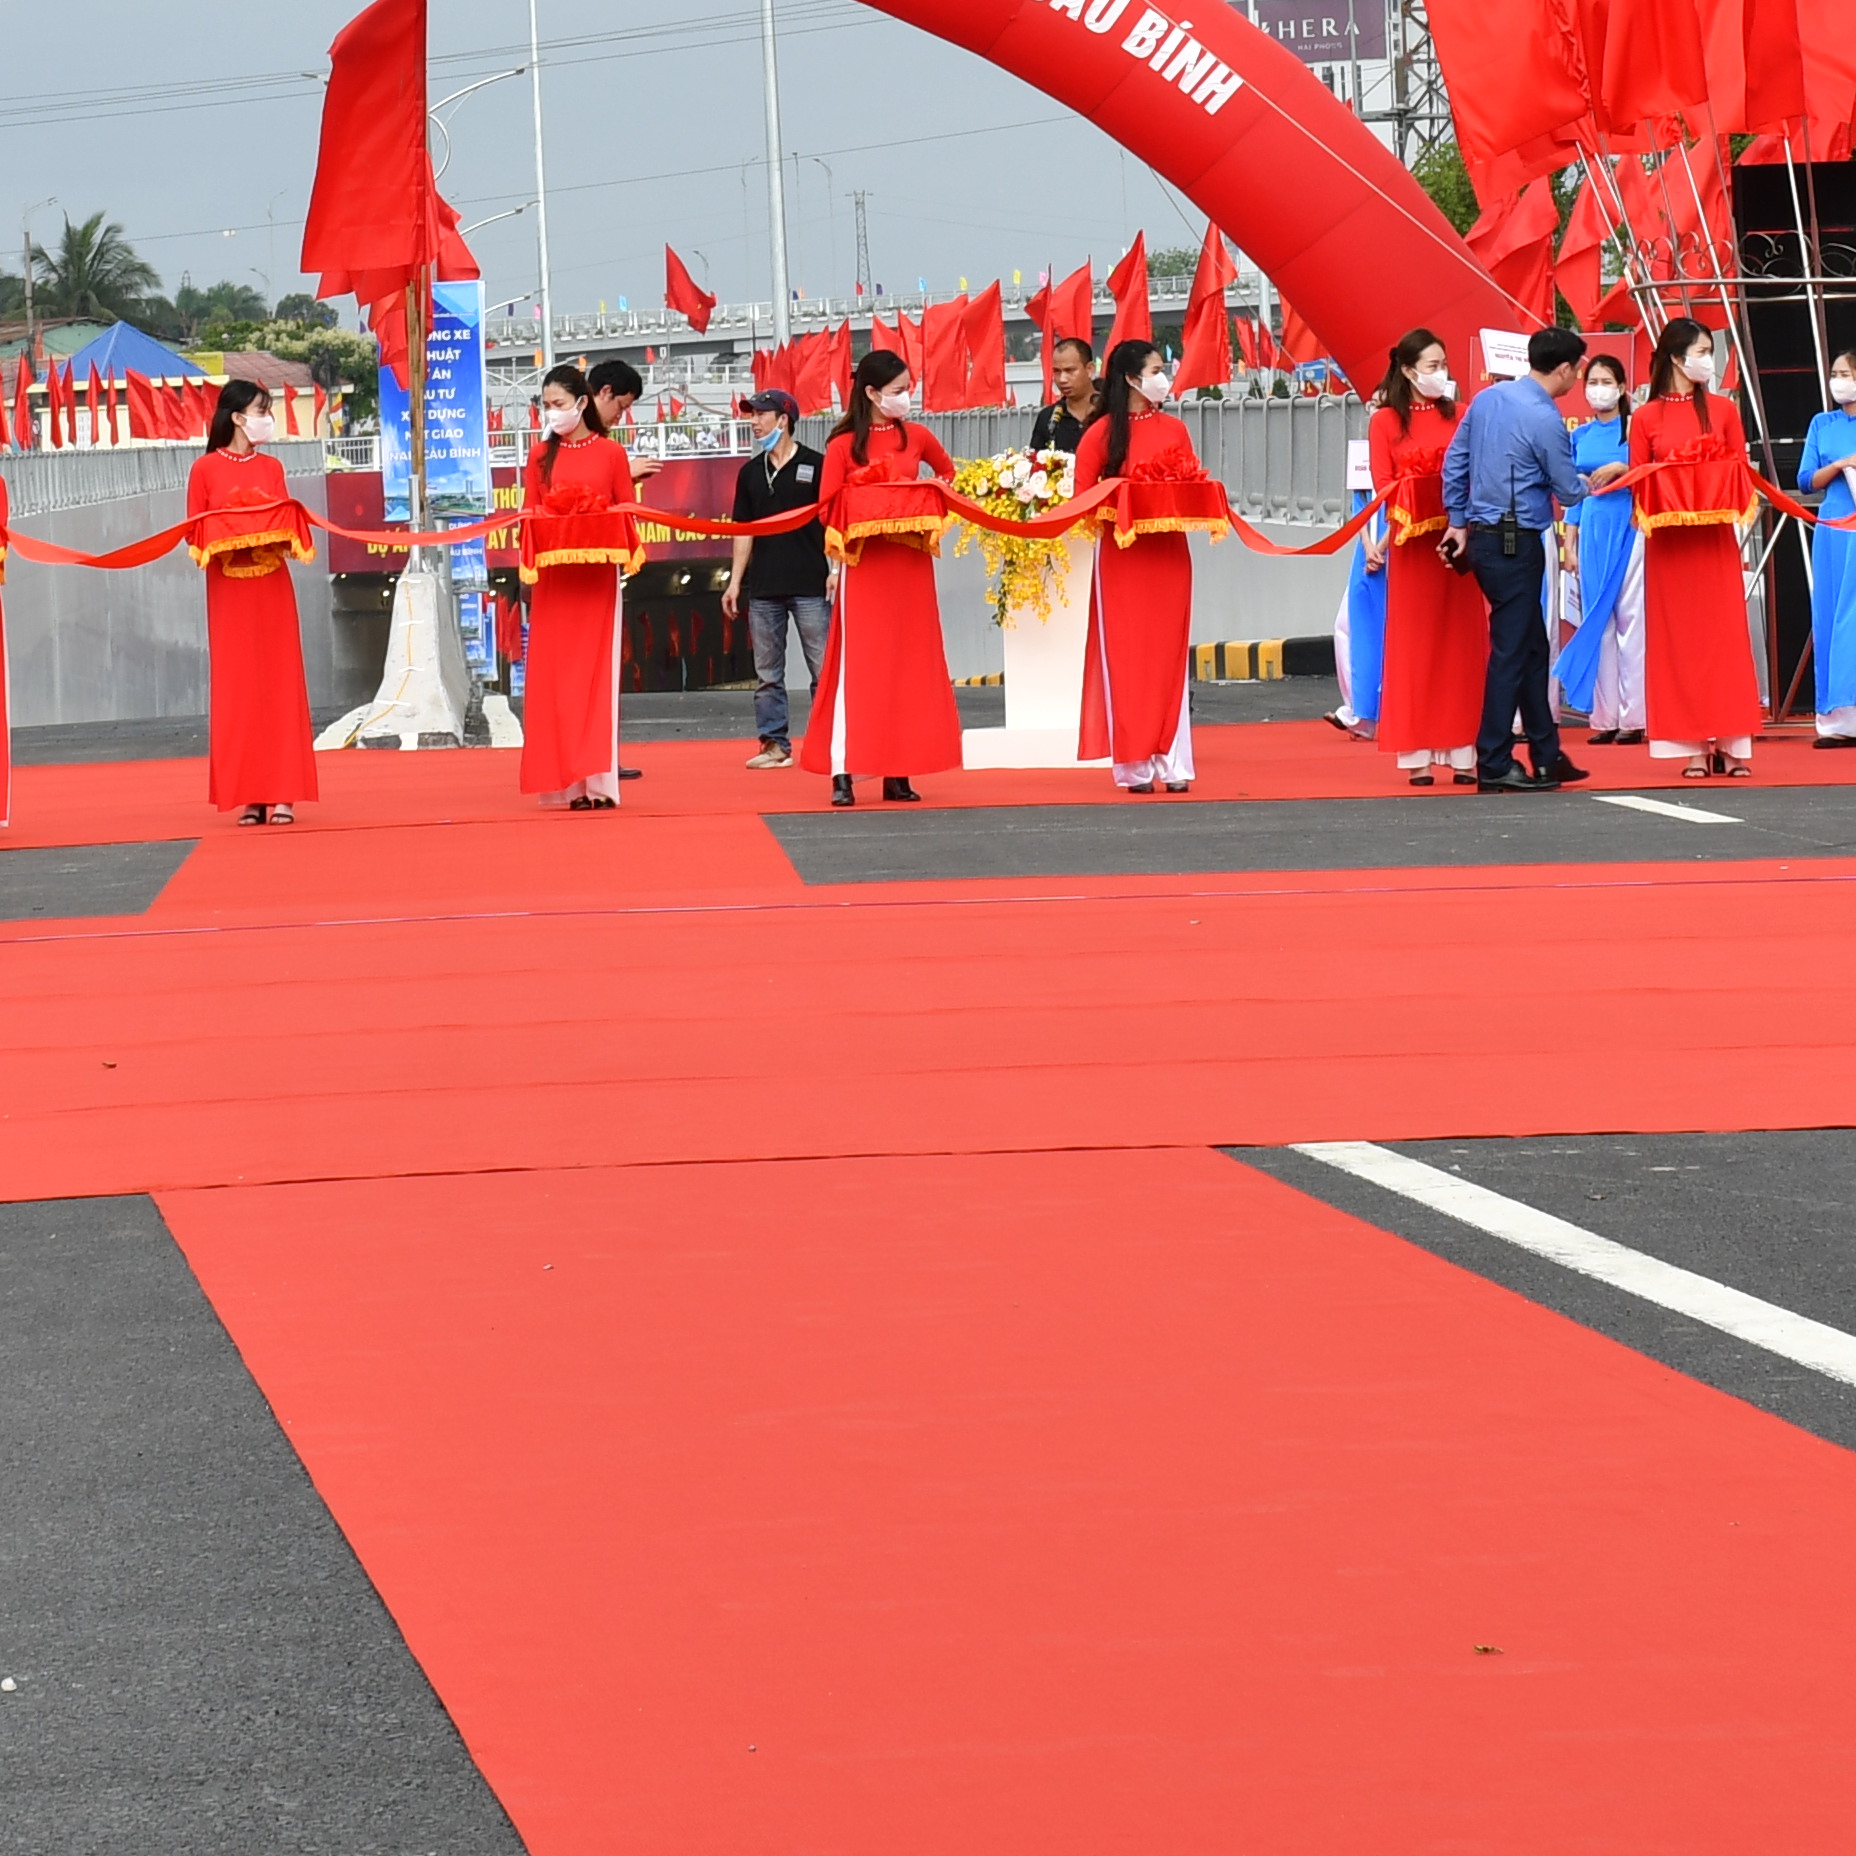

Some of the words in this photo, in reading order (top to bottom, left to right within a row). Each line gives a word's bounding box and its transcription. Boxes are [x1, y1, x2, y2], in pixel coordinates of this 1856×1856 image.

[1278, 18, 1360, 40] HERA
[1120, 7, 1244, 116] BÍNH
[454, 329, 471, 341] XE
[427, 349, 461, 363] HUẬT
[438, 387, 456, 400] TƯ
[428, 408, 466, 423] DỰNG
[432, 428, 464, 440] GIAO
